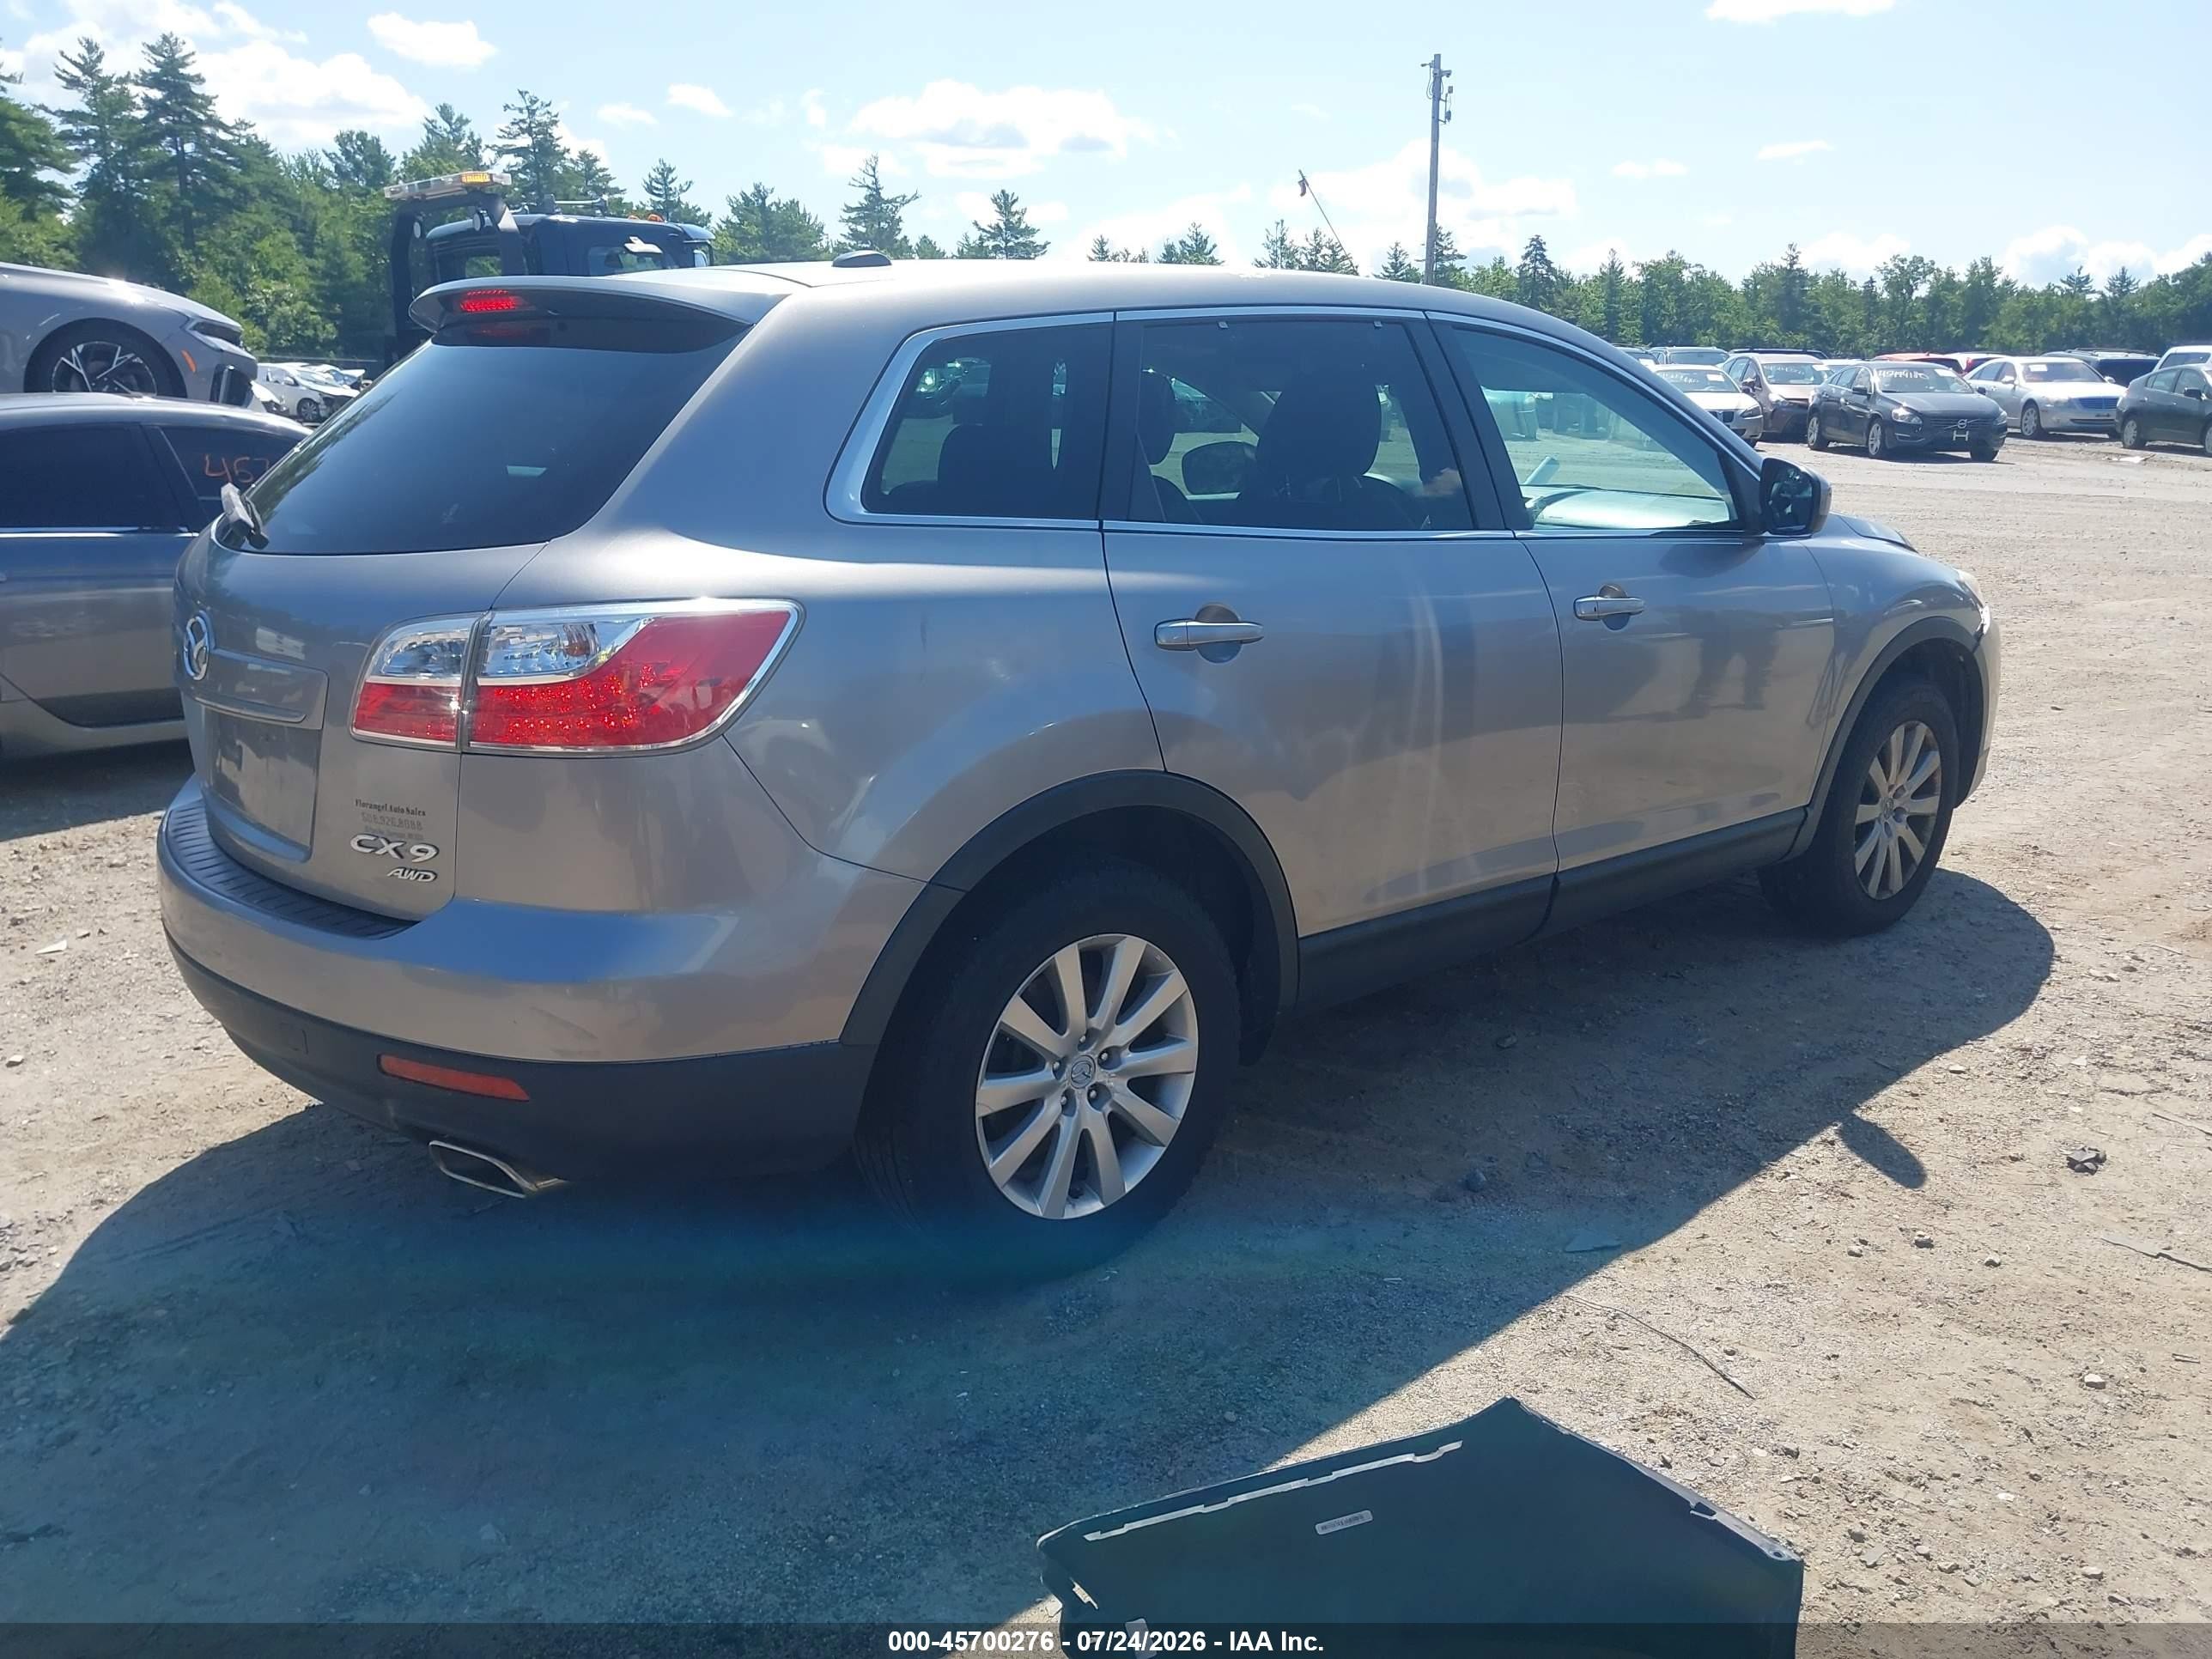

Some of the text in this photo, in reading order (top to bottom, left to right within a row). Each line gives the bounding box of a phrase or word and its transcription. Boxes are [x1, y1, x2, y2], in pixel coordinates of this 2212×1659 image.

[388, 805, 405, 814] Auto
[406, 807, 427, 817] Sales
[386, 866, 438, 883] AWD
